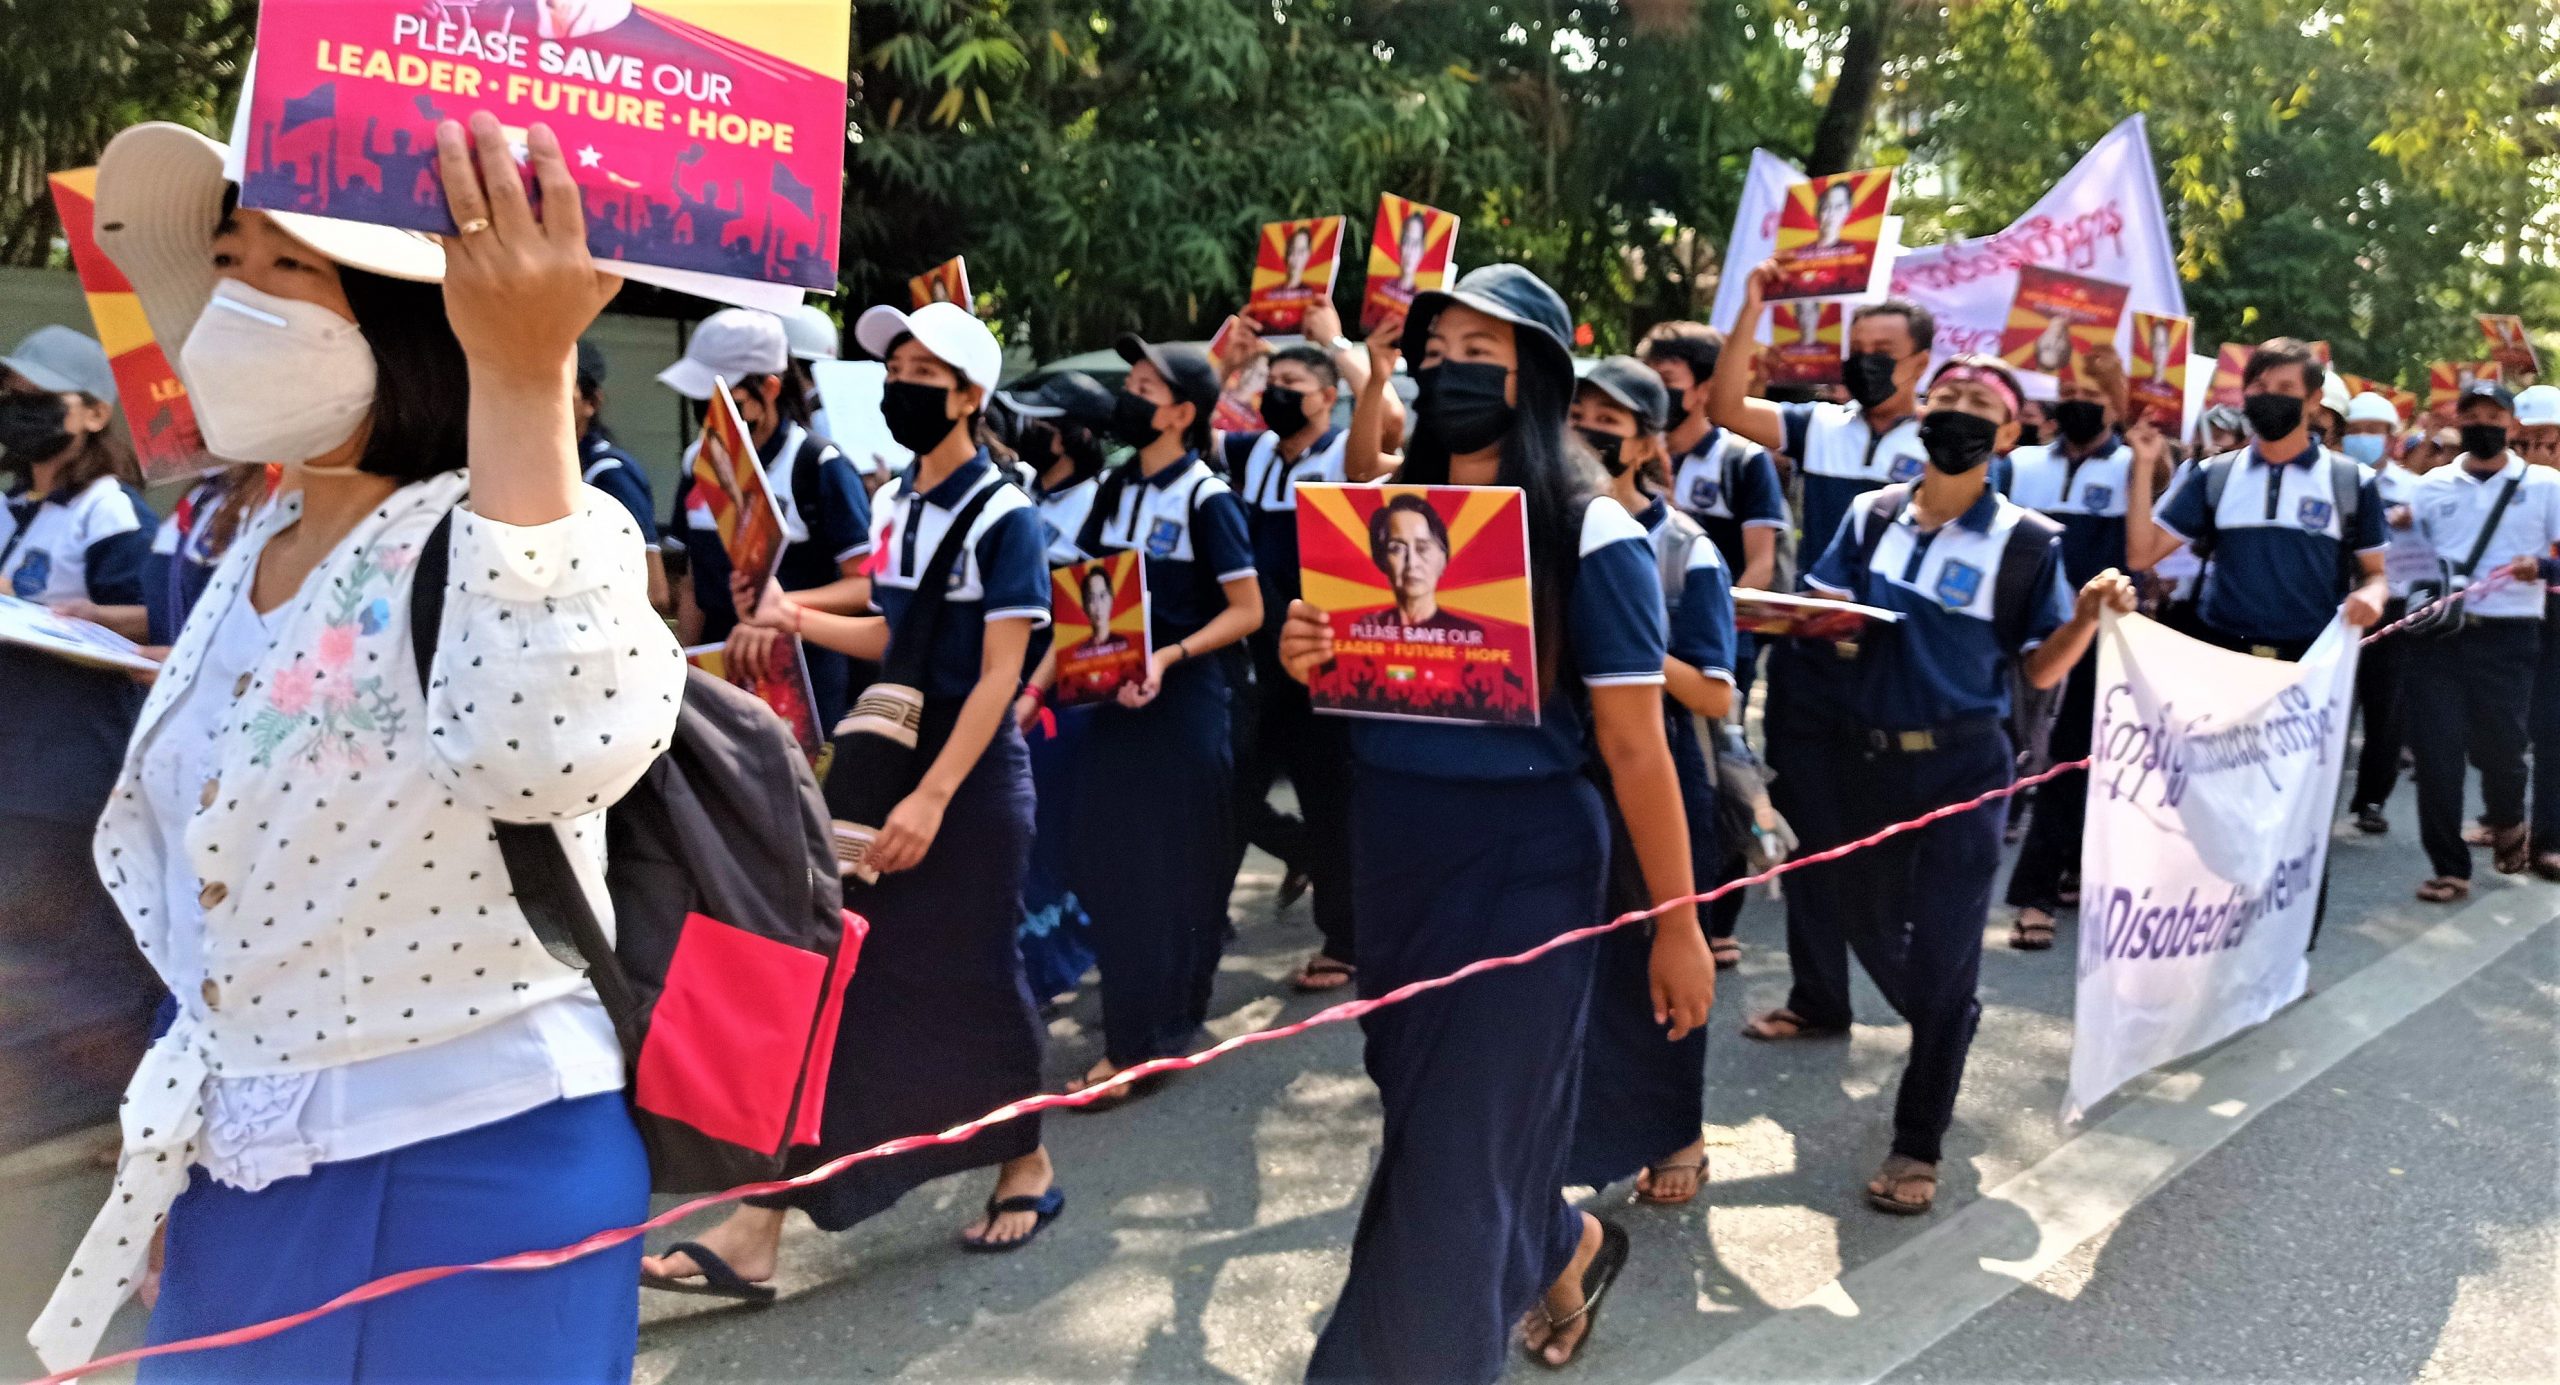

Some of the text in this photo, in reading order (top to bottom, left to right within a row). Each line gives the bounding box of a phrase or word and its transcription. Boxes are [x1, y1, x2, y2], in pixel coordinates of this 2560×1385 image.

[393, 13, 733, 106] PLEASE SAVE OUR
[316, 39, 795, 154] LEADER FUTURE HOPE
[1333, 638, 1512, 664] EADER FUTURE HOPE
[1350, 623, 1484, 645] PLEASE SAVE OUR
